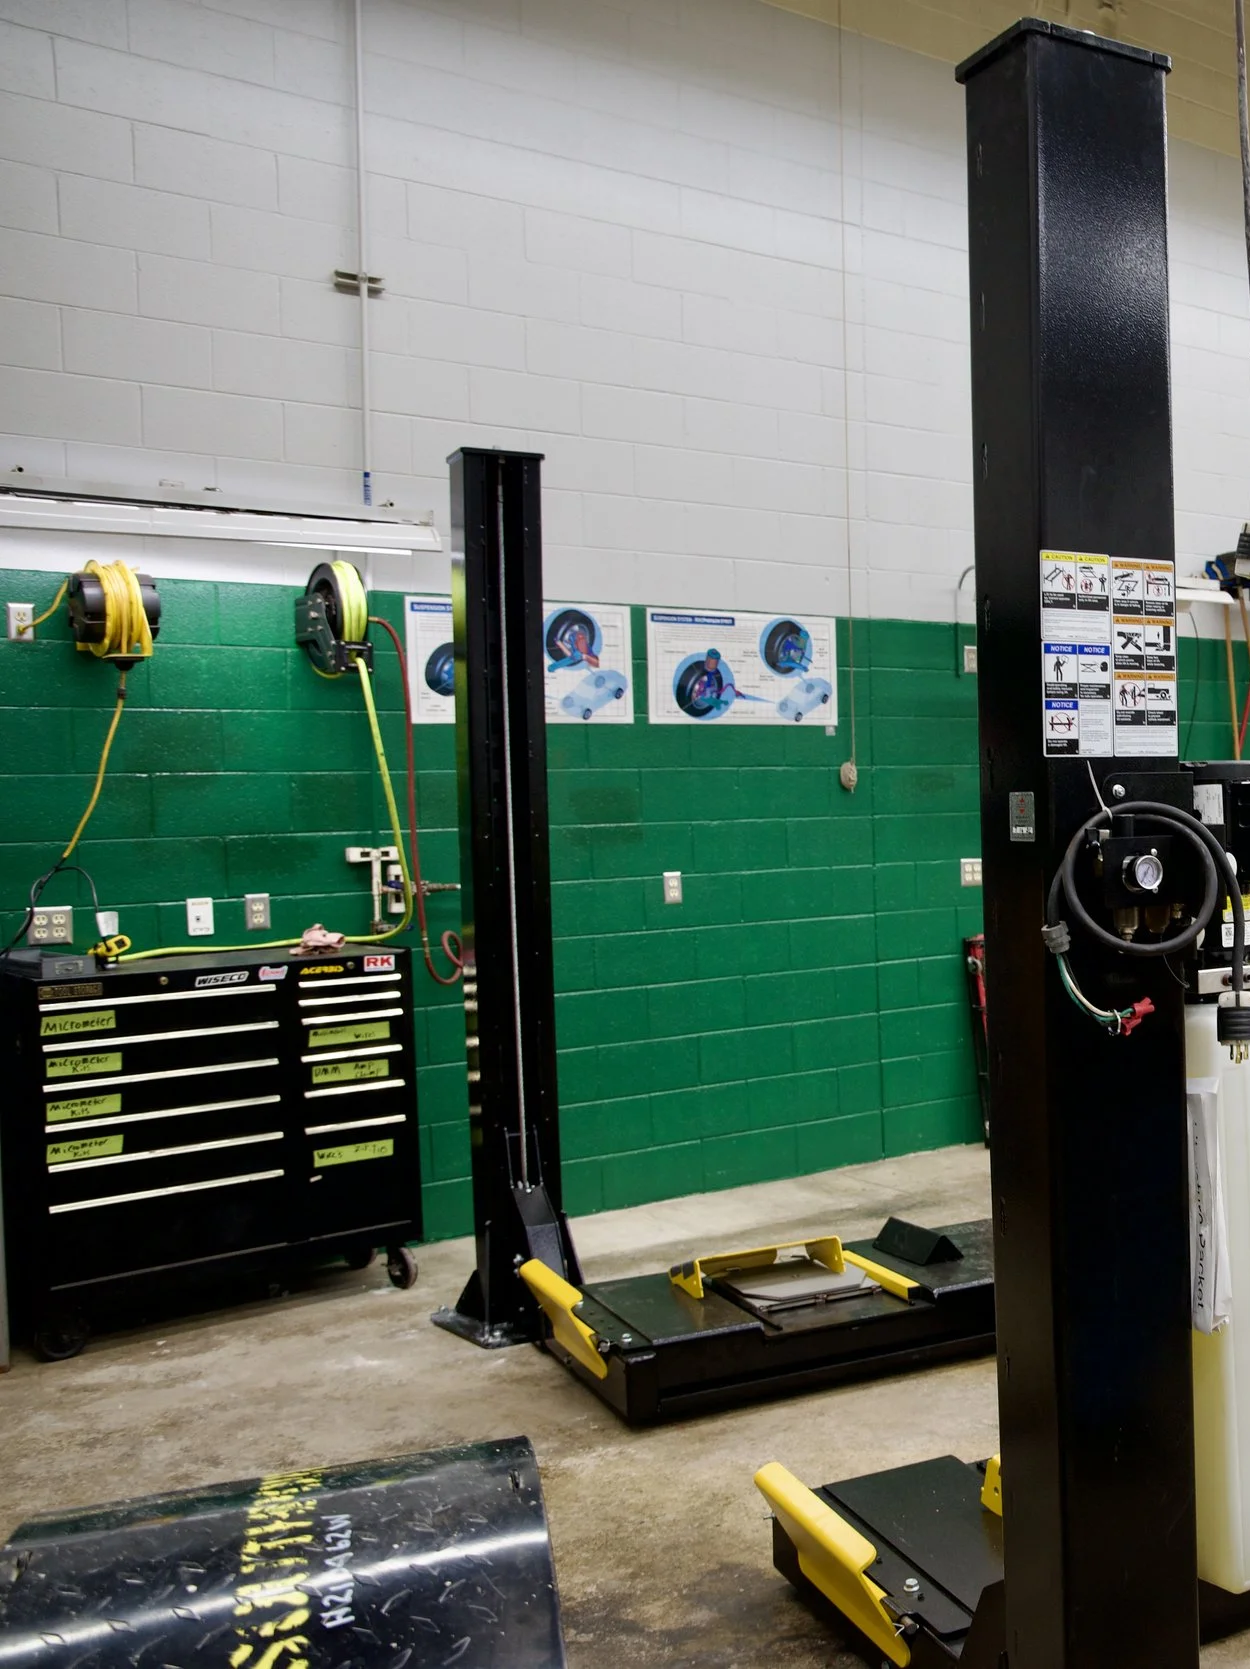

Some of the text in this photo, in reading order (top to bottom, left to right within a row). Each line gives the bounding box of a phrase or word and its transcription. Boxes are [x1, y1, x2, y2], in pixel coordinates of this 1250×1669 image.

[1050, 645, 1073, 653] NOTICE
[1084, 646, 1105, 654] NOTICE
[1051, 701, 1074, 709] NOTICE
[366, 956, 393, 967] RK
[197, 972, 247, 987] WISECO
